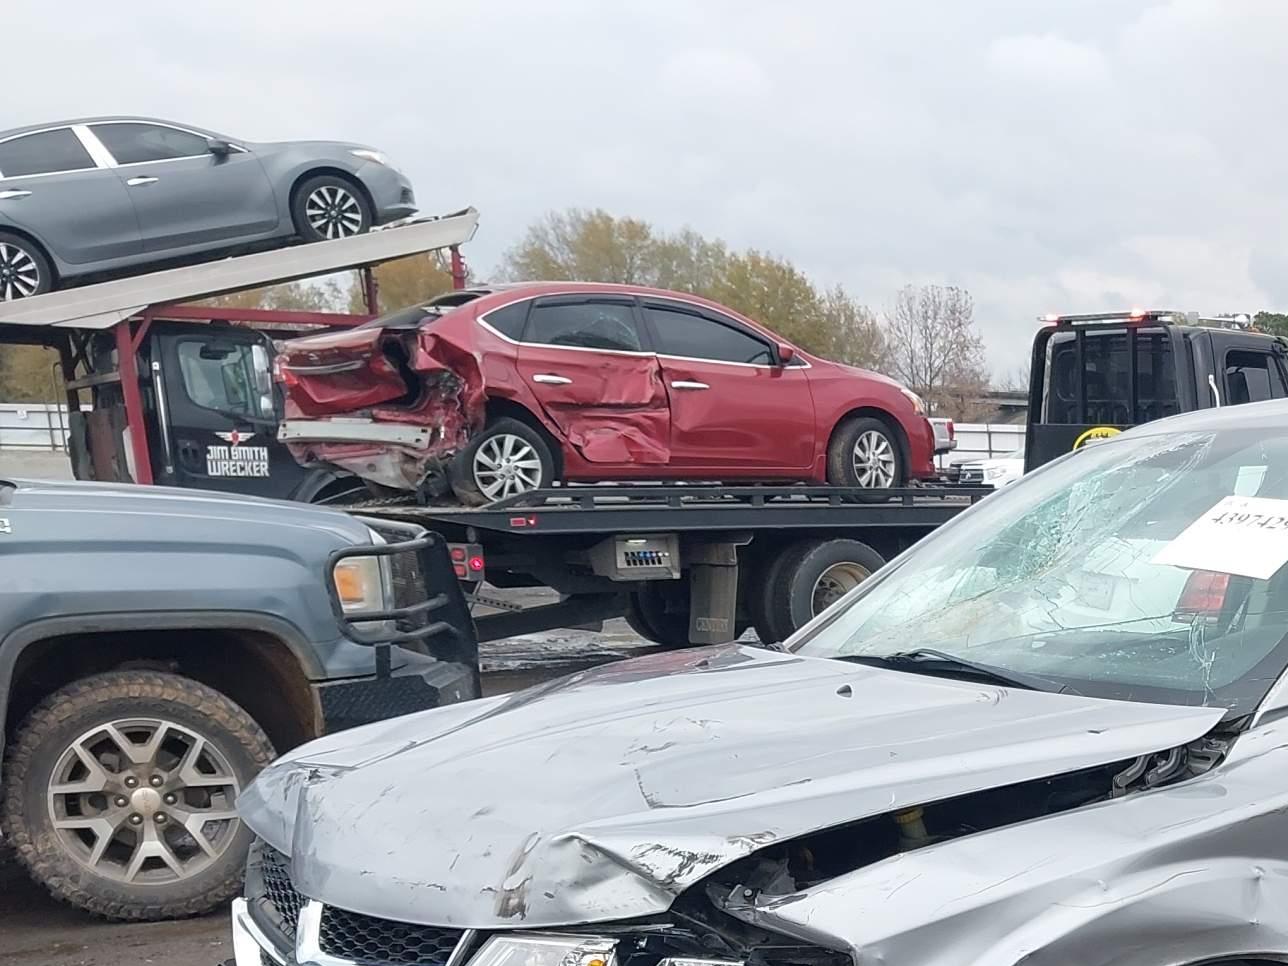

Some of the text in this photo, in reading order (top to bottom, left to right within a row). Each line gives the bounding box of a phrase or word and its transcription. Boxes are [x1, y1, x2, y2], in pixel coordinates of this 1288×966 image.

[206, 445, 269, 461] JIM SMITH
[206, 460, 271, 477] WRECKER
